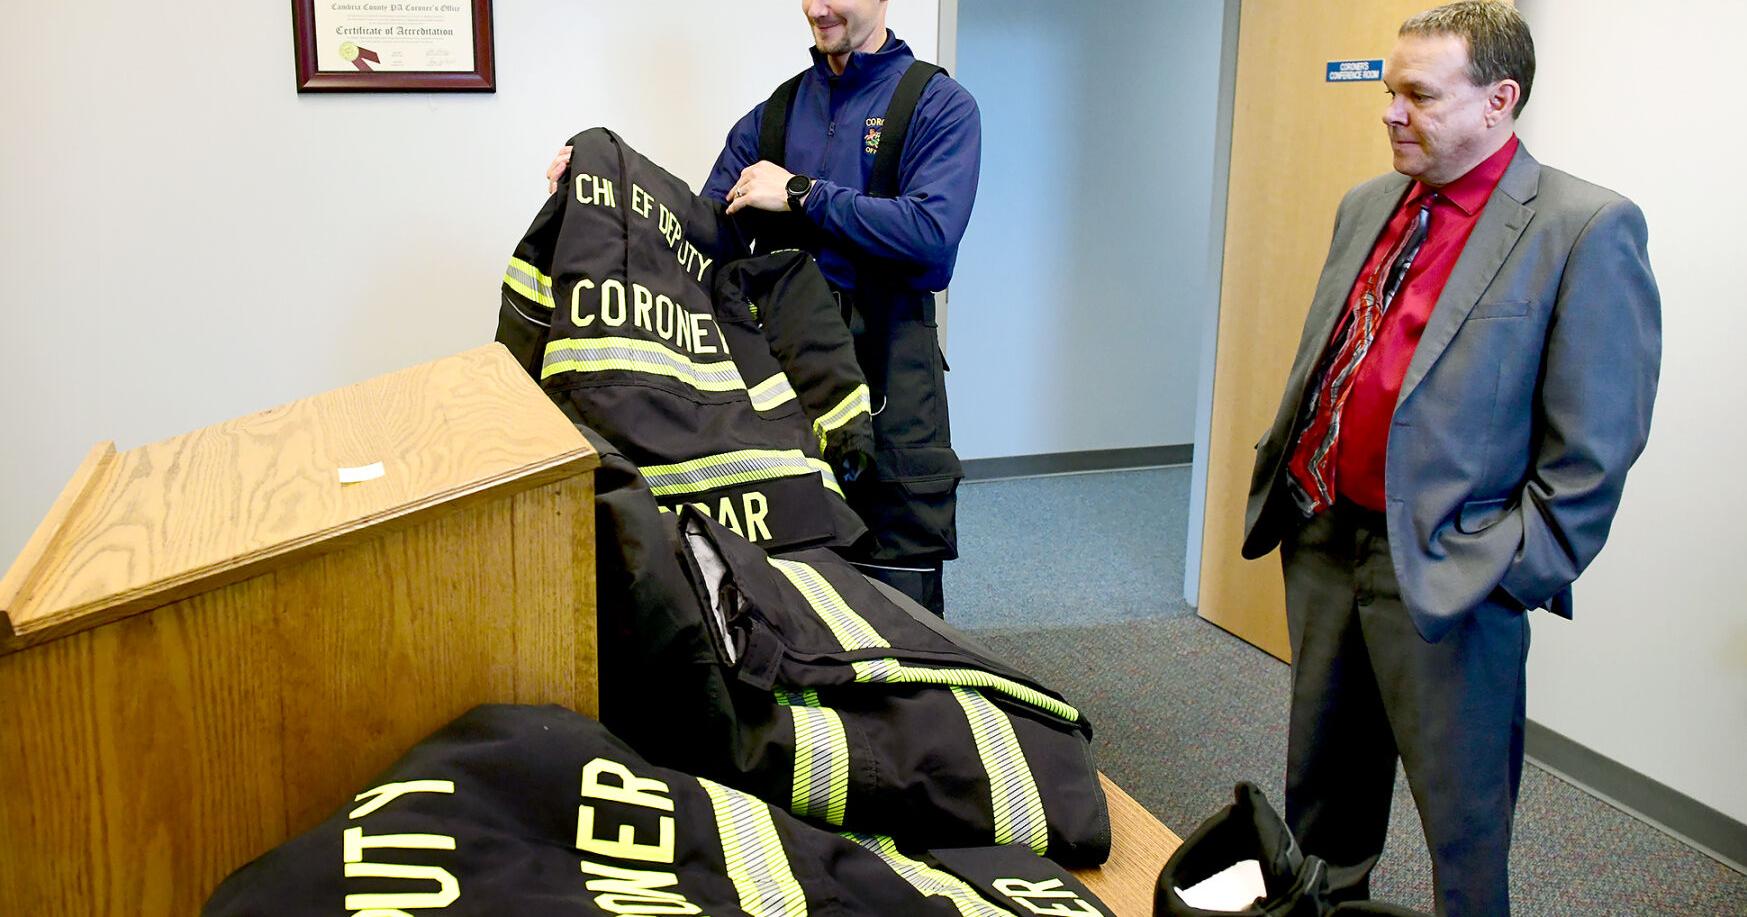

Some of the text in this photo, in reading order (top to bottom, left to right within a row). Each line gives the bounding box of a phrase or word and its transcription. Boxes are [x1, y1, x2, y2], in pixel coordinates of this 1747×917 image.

[331, 3, 461, 12] Cambria County PA Coroner's Office
[336, 25, 453, 36] Certificate of Accreditation
[1329, 70, 1380, 80] CONFERENCE ROOM
[658, 203, 713, 282] DEPUTY
[343, 779, 461, 917] UTY
[575, 757, 703, 917] ONER
